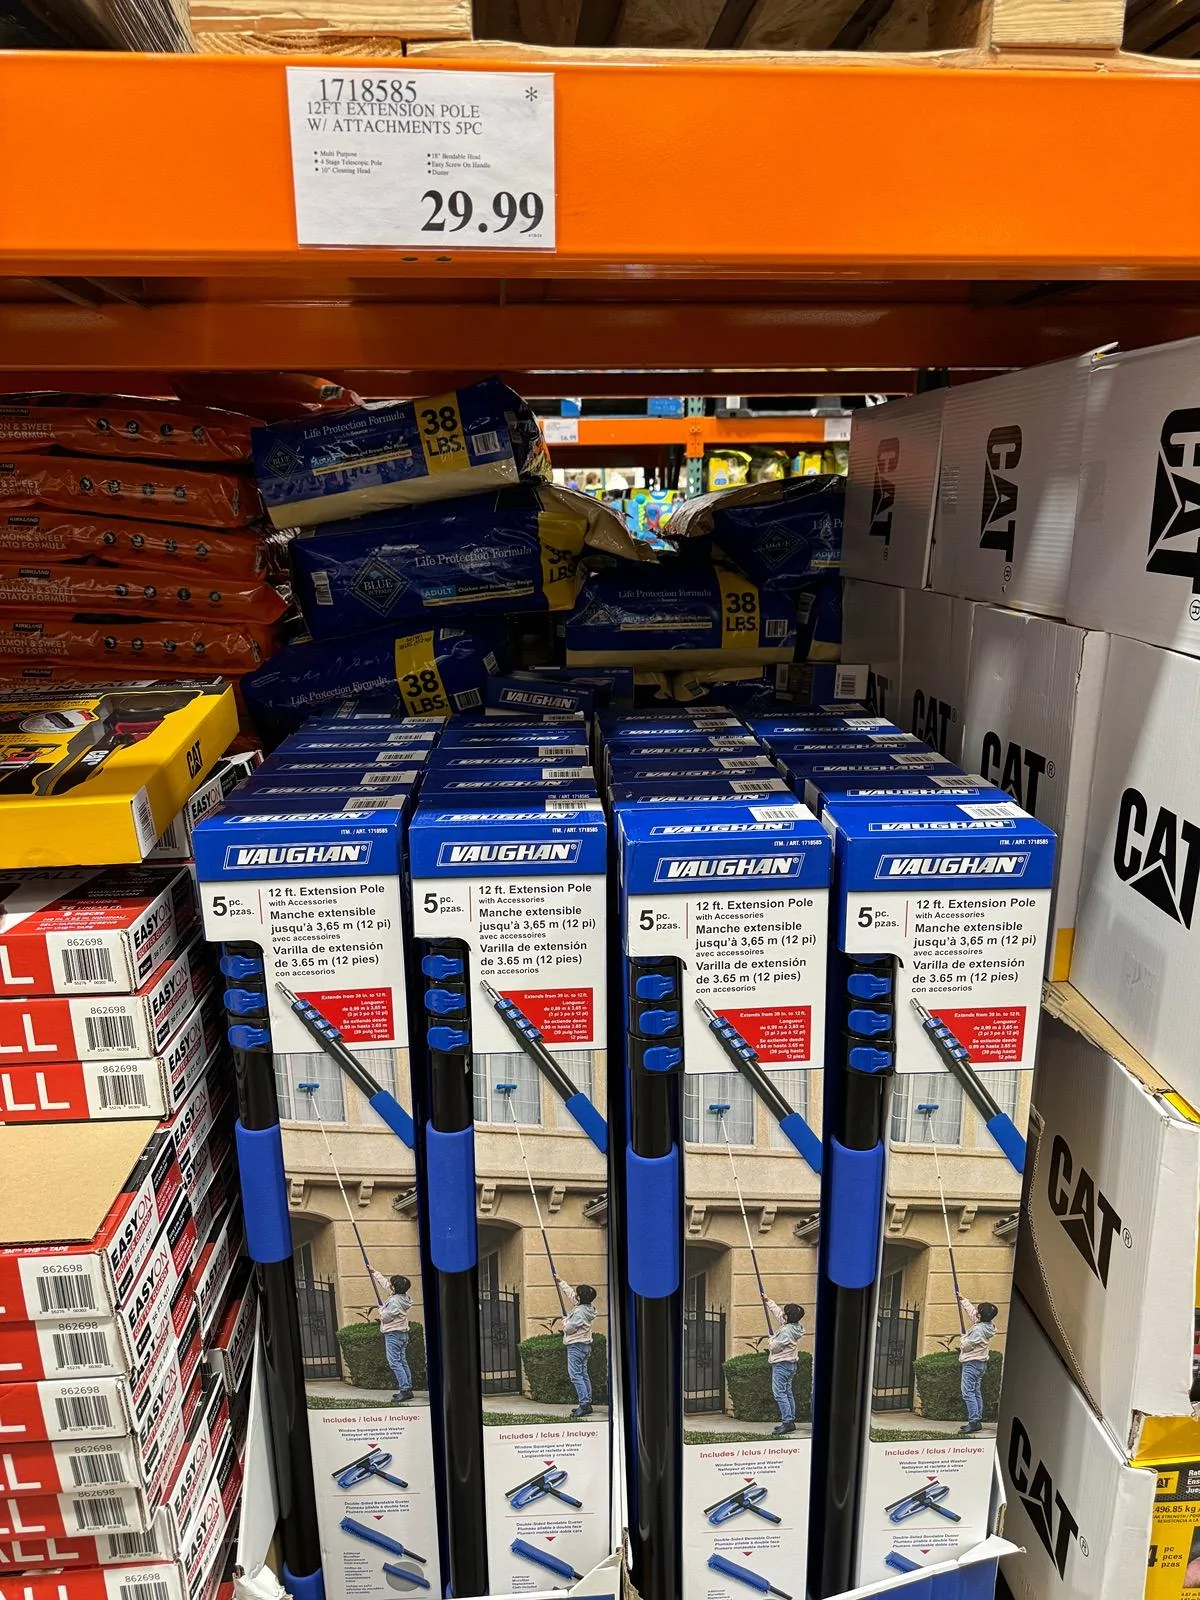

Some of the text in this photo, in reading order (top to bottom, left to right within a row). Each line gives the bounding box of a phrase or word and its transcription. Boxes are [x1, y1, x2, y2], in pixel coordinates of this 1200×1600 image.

[320, 79, 417, 102] 1718585
[307, 101, 480, 118] 12FT EXTENSION POLE
[308, 118, 482, 135] W/ ATTACHMENTS 5PC
[325, 159, 340, 167] Stage
[332, 167, 355, 175] Cleaning
[420, 190, 544, 234] 29.99
[303, 411, 405, 440] Life Protection Formula
[420, 406, 458, 436] 38
[426, 434, 466, 456] LBS.
[869, 437, 900, 545] CAT
[980, 425, 1022, 562] CAT
[1146, 407, 1200, 594] CAT
[415, 546, 532, 568] Life Protection Formula
[363, 579, 393, 592] BLUE
[424, 587, 452, 597] ADULT
[619, 589, 712, 599] Life Protection Formula
[726, 592, 757, 614] 38
[726, 616, 758, 632] LBS.
[402, 670, 439, 698] 38
[308, 686, 350, 703] Protection
[502, 691, 573, 709] VAUGHAN
[410, 698, 448, 717] LBS.
[186, 740, 204, 780] CAT
[980, 731, 1046, 816] CAT
[663, 823, 783, 833] VAUGHAN
[882, 821, 1004, 830] VAUGHAN
[237, 846, 360, 865] VAUGHAN
[450, 844, 570, 862] VAUGHAN
[1113, 787, 1200, 930] CAT
[667, 858, 792, 878] VAUGHAN
[889, 857, 1017, 875] VAUGHAN
[213, 896, 243, 917] 5 pc.
[424, 893, 453, 913] 5 pc.
[440, 905, 464, 914] pzas.
[696, 898, 813, 911] 12 ft. Extension Pole
[916, 898, 1036, 909] 12 ft. Extension Pole
[230, 909, 254, 918] pzas.
[640, 910, 670, 930] 5 pc.
[715, 912, 764, 920] Accessories
[858, 907, 889, 928] 5 pc.
[656, 922, 680, 931] pzas.
[696, 922, 802, 934] Manche extensible
[875, 920, 899, 928] pzas.
[915, 921, 1023, 932] Manche extensible
[67, 938, 103, 946] 862698
[695, 934, 816, 950] jusqu'à 3,65 m (12 pi)
[913, 935, 1036, 949] jusqu'à 3,65 m (12 pi)
[717, 949, 764, 957] accessoires
[696, 957, 806, 971] Varilla de extensión
[913, 958, 1025, 970] Varilla de extensión
[696, 975, 709, 984] de
[713, 974, 736, 983] 3.65
[753, 972, 770, 983] (12
[774, 971, 801, 983] pies)
[912, 975, 925, 983] de
[930, 974, 953, 983] 3.65
[970, 972, 987, 983] (12
[991, 972, 1018, 983] pies)
[713, 985, 756, 993] accesorios
[90, 1006, 126, 1014] 862698
[102, 1065, 138, 1073] 862698
[1048, 1134, 1122, 1290] CAT
[111, 1188, 151, 1270] EASYON
[134, 1203, 153, 1243] GUARD
[42, 1264, 83, 1273] 862698
[61, 1386, 100, 1395] 862698
[74, 1444, 113, 1453] 862698
[1008, 1416, 1079, 1581] CAT
[184, 1491, 218, 1571] EASYON
[1162, 1553, 1183, 1561] pces
[1164, 1545, 1174, 1553] pc
[125, 1573, 161, 1582] 862698
